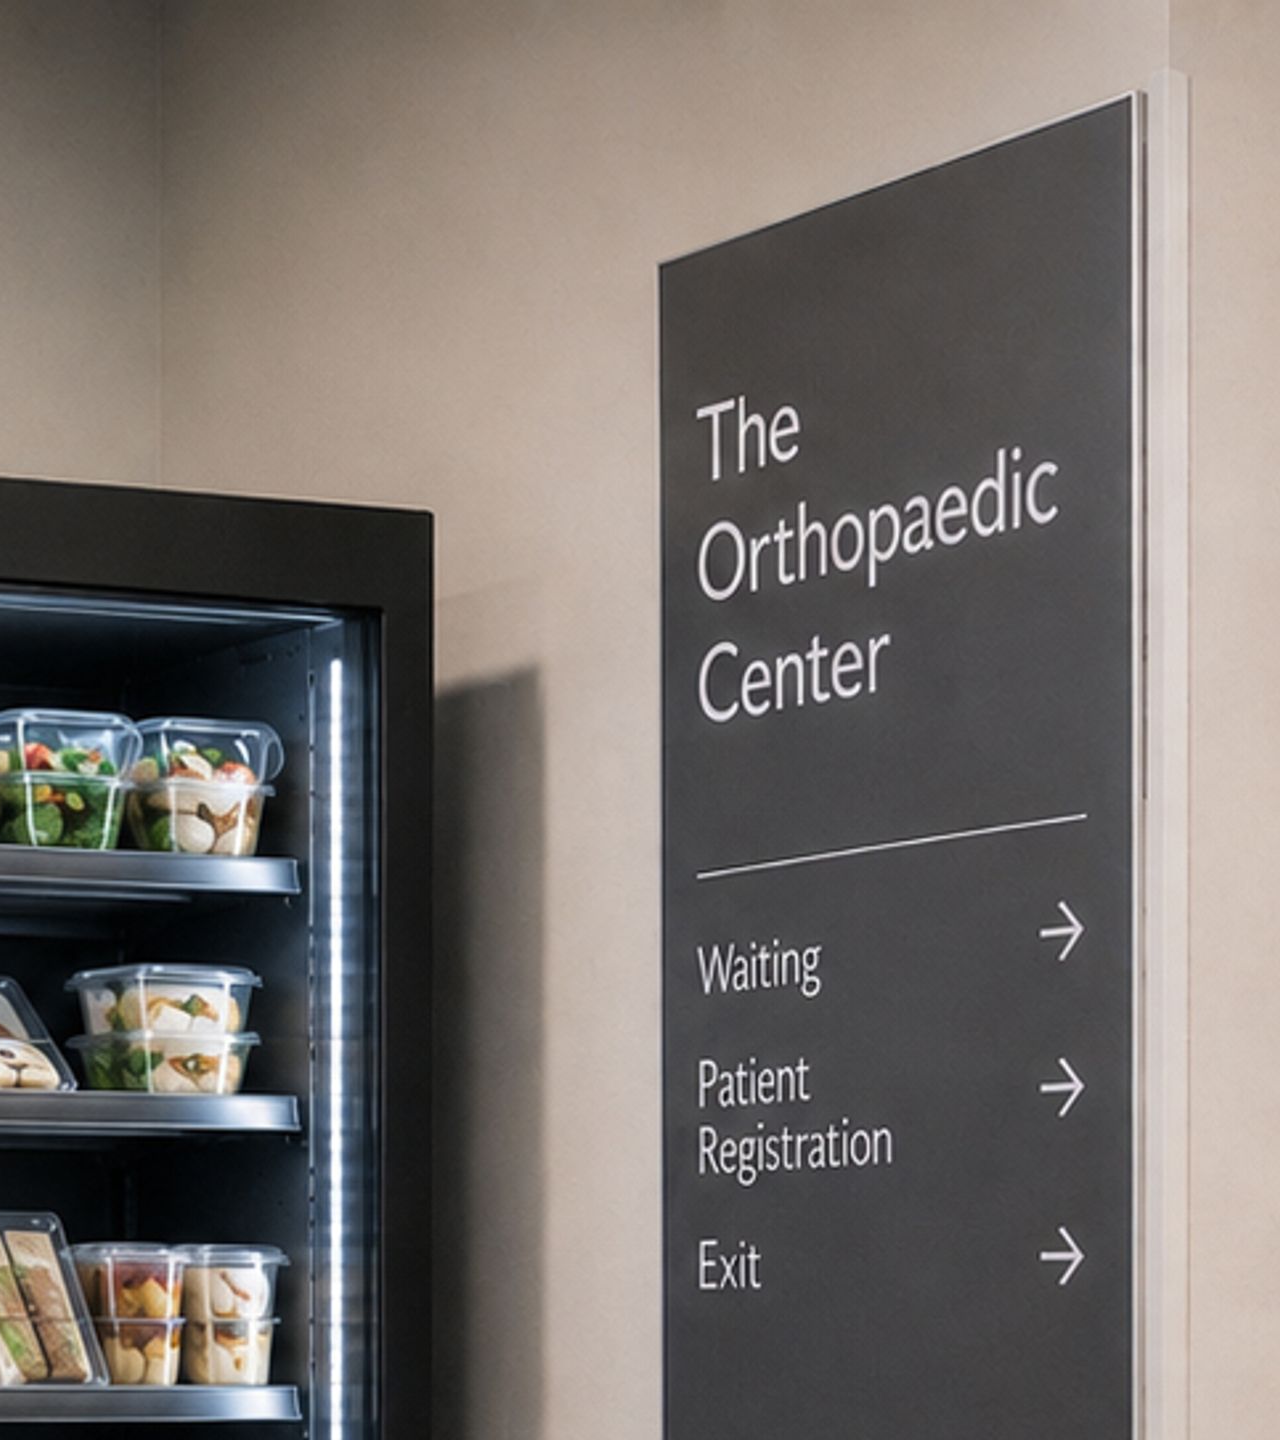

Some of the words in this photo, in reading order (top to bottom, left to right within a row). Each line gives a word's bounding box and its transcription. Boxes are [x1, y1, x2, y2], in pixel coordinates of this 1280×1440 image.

[696, 395, 800, 481] The
[698, 446, 1059, 601] Orthopaedic
[698, 633, 891, 723] Center
[697, 938, 822, 998] Waiting
[698, 1057, 811, 1108] Patient
[699, 1117, 892, 1187] Registration
[699, 1239, 762, 1290] Exit
